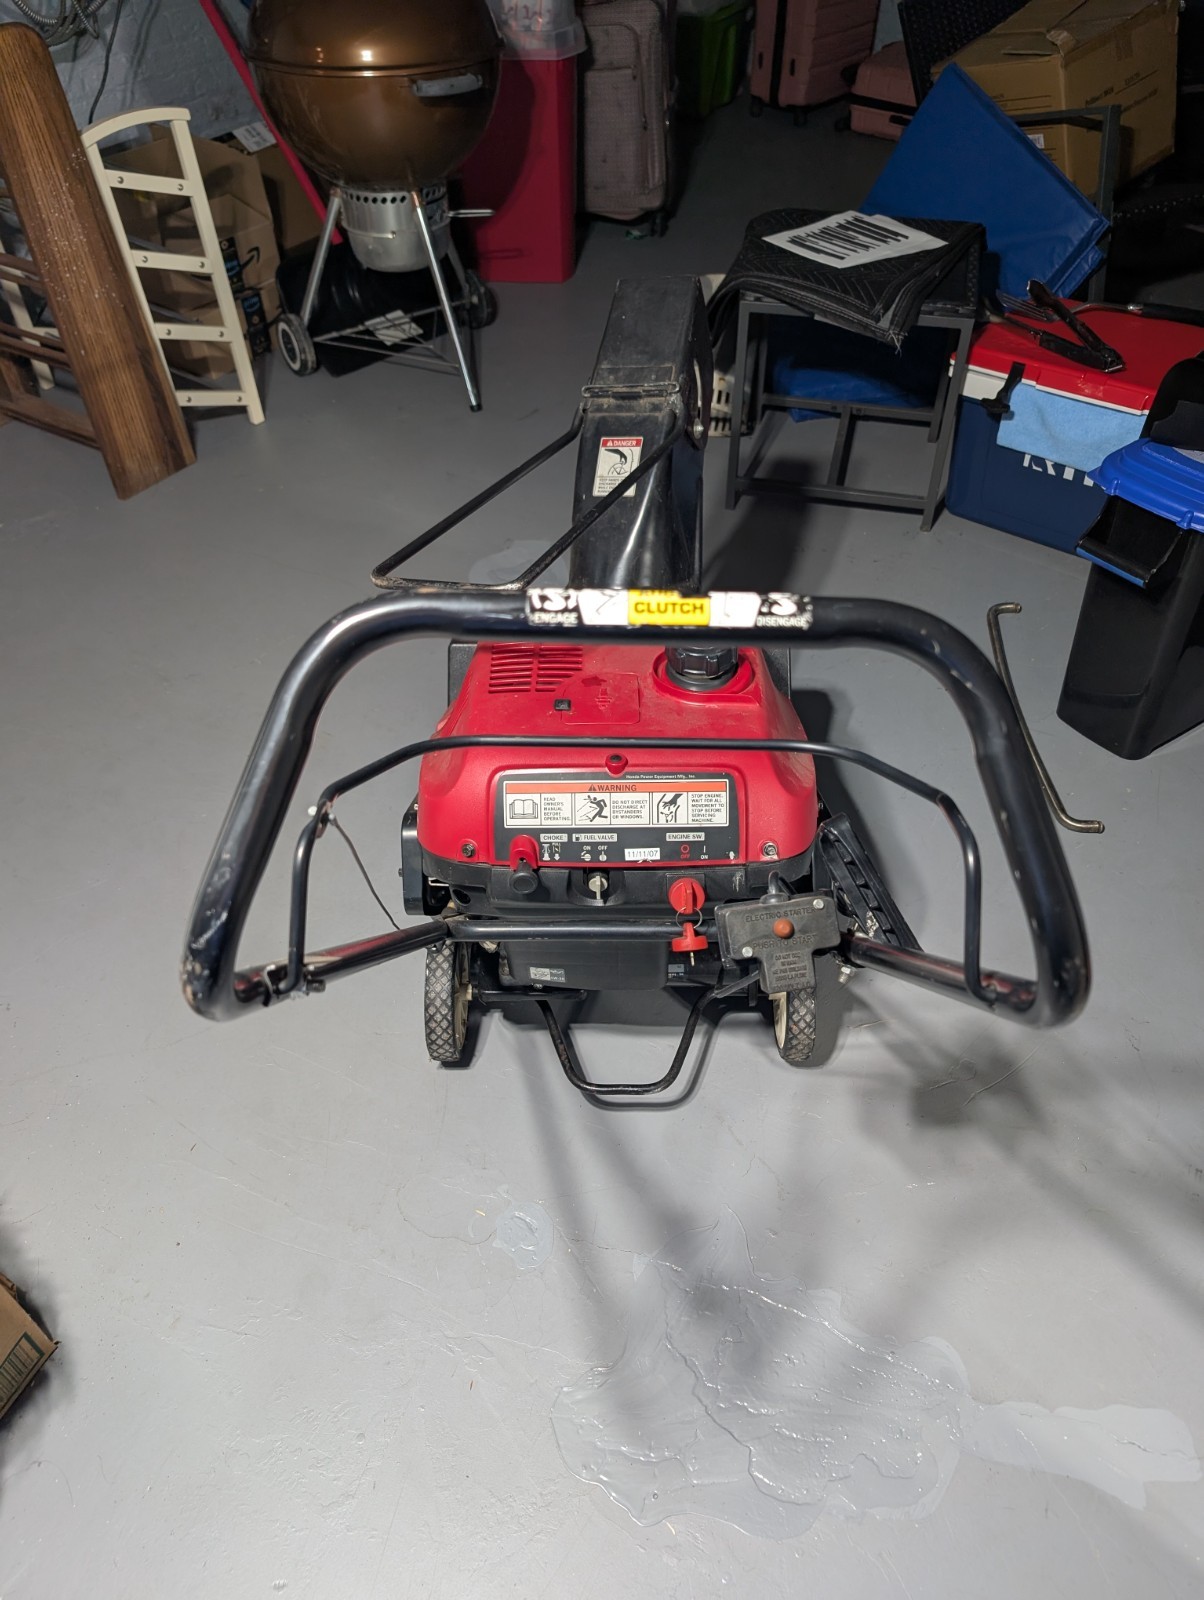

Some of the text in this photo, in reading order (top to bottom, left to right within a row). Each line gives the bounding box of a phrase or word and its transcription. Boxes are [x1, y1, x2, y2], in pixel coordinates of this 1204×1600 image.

[634, 602, 704, 614] CLUTCH
[534, 612, 578, 624] ENGAGE
[756, 615, 807, 628] DISENGAGE
[746, 906, 816, 922] ELECTRIC STARTER
